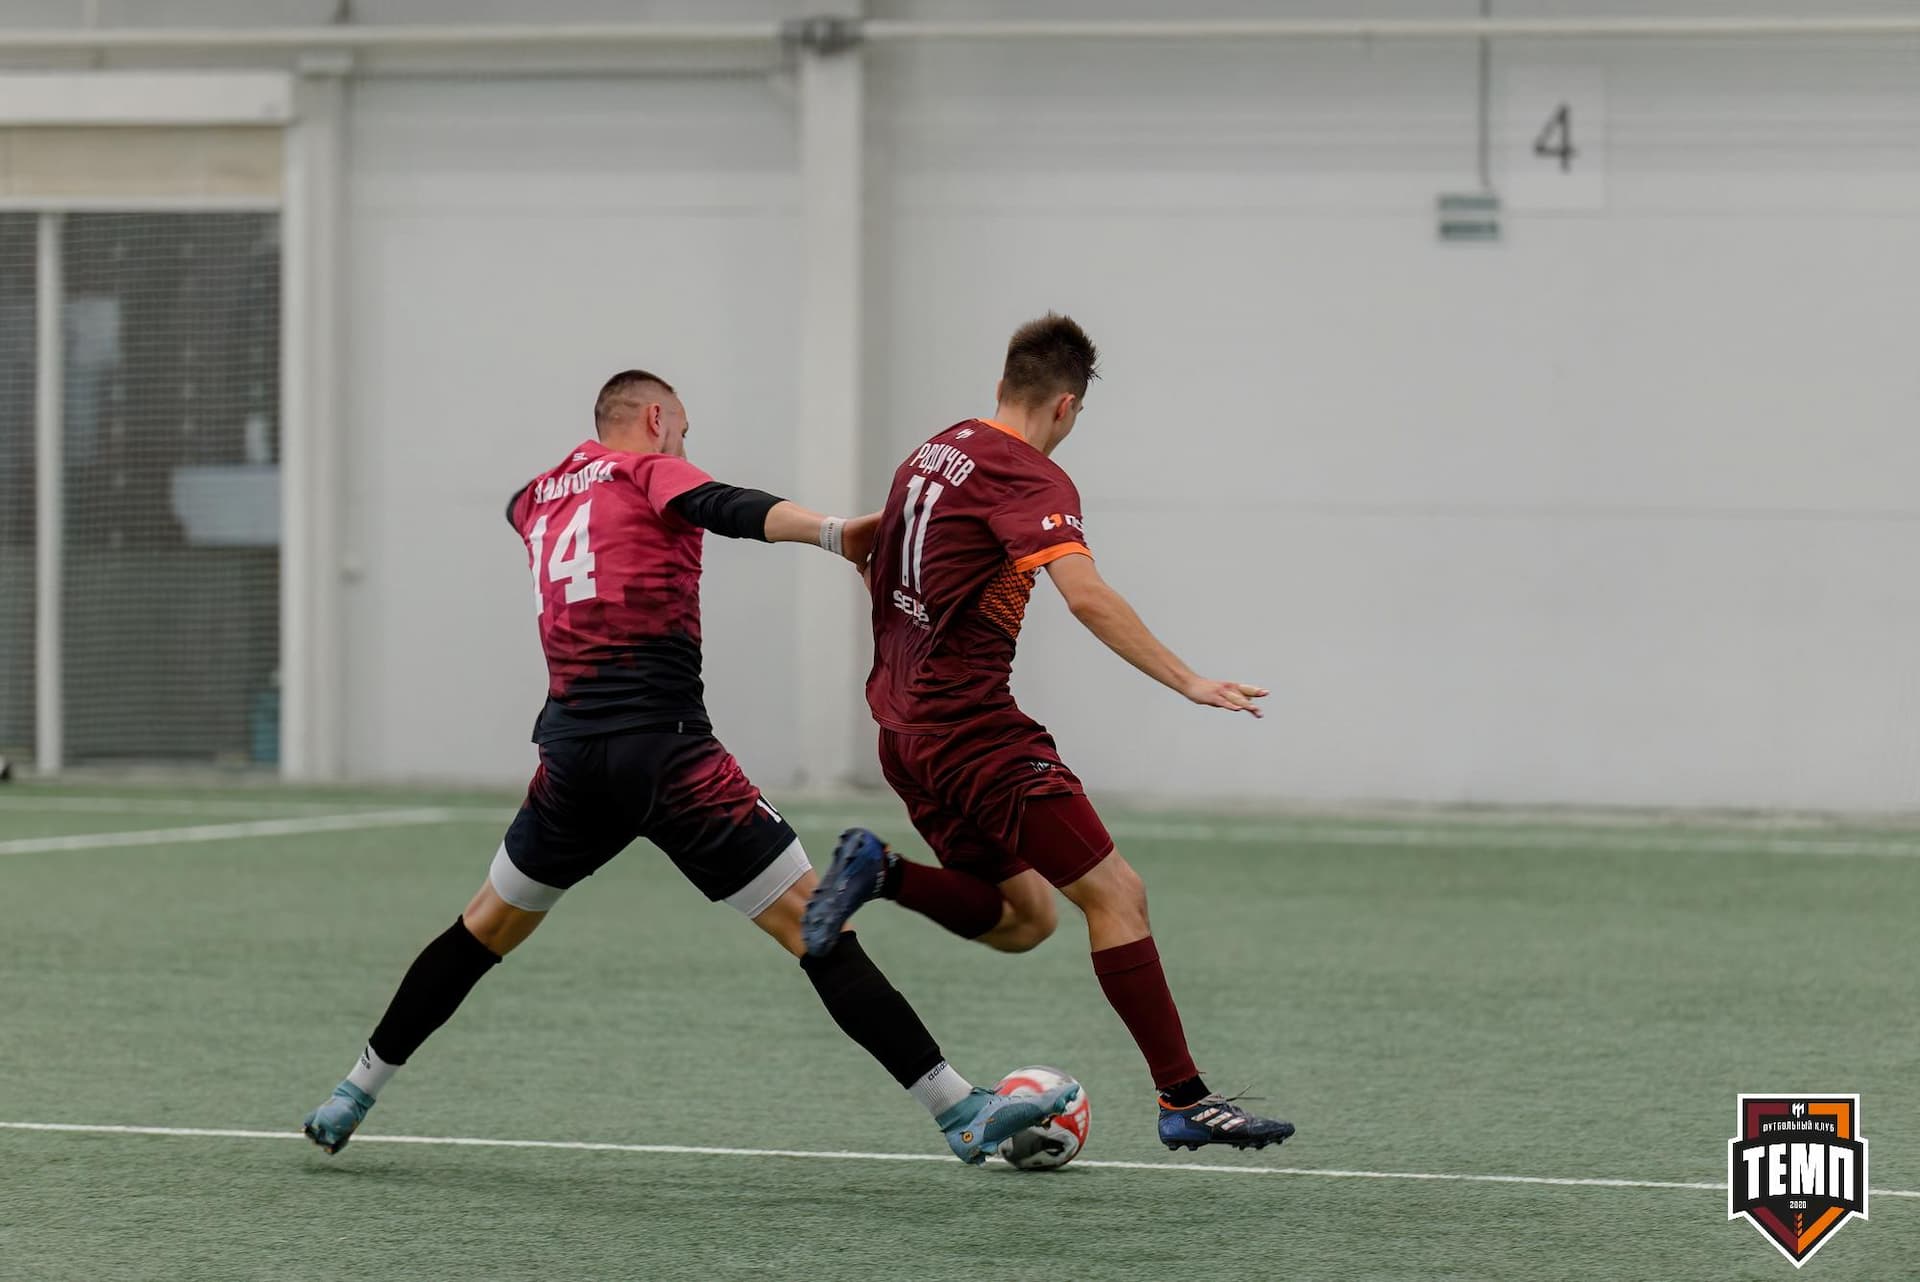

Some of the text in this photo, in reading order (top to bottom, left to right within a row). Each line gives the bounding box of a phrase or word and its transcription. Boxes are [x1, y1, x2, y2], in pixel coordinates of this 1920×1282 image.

[1533, 103, 1581, 171] 4
[529, 499, 597, 615] 14
[903, 474, 945, 595] 11
